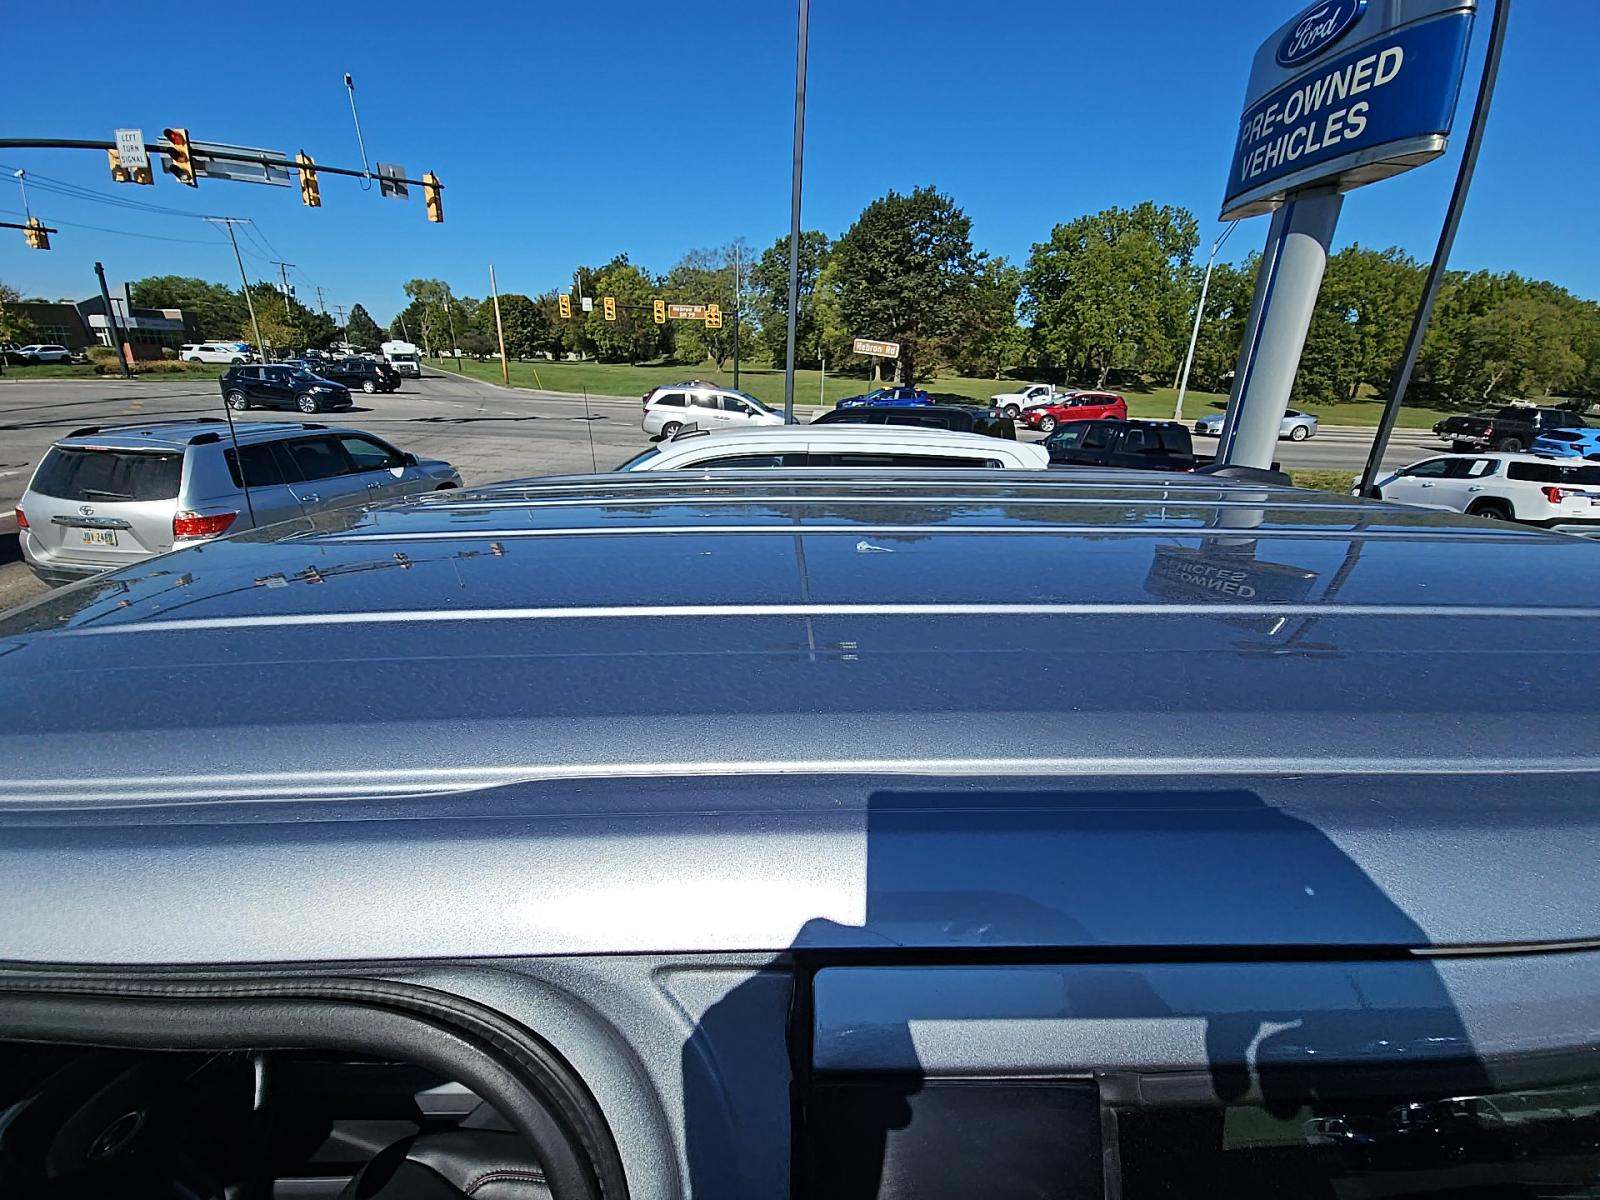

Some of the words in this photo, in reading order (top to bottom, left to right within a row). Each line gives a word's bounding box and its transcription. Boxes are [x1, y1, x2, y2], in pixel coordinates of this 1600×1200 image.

[1287, 6, 1342, 57] Ford
[1240, 46, 1404, 150] PRE-OWNED
[121, 134, 136, 142] LEFT
[1241, 101, 1369, 182] VEHICLES
[122, 145, 140, 153] TURN
[121, 155, 145, 163] SIGNAL
[856, 341, 882, 353] Hebron
[885, 345, 896, 355] Rd
